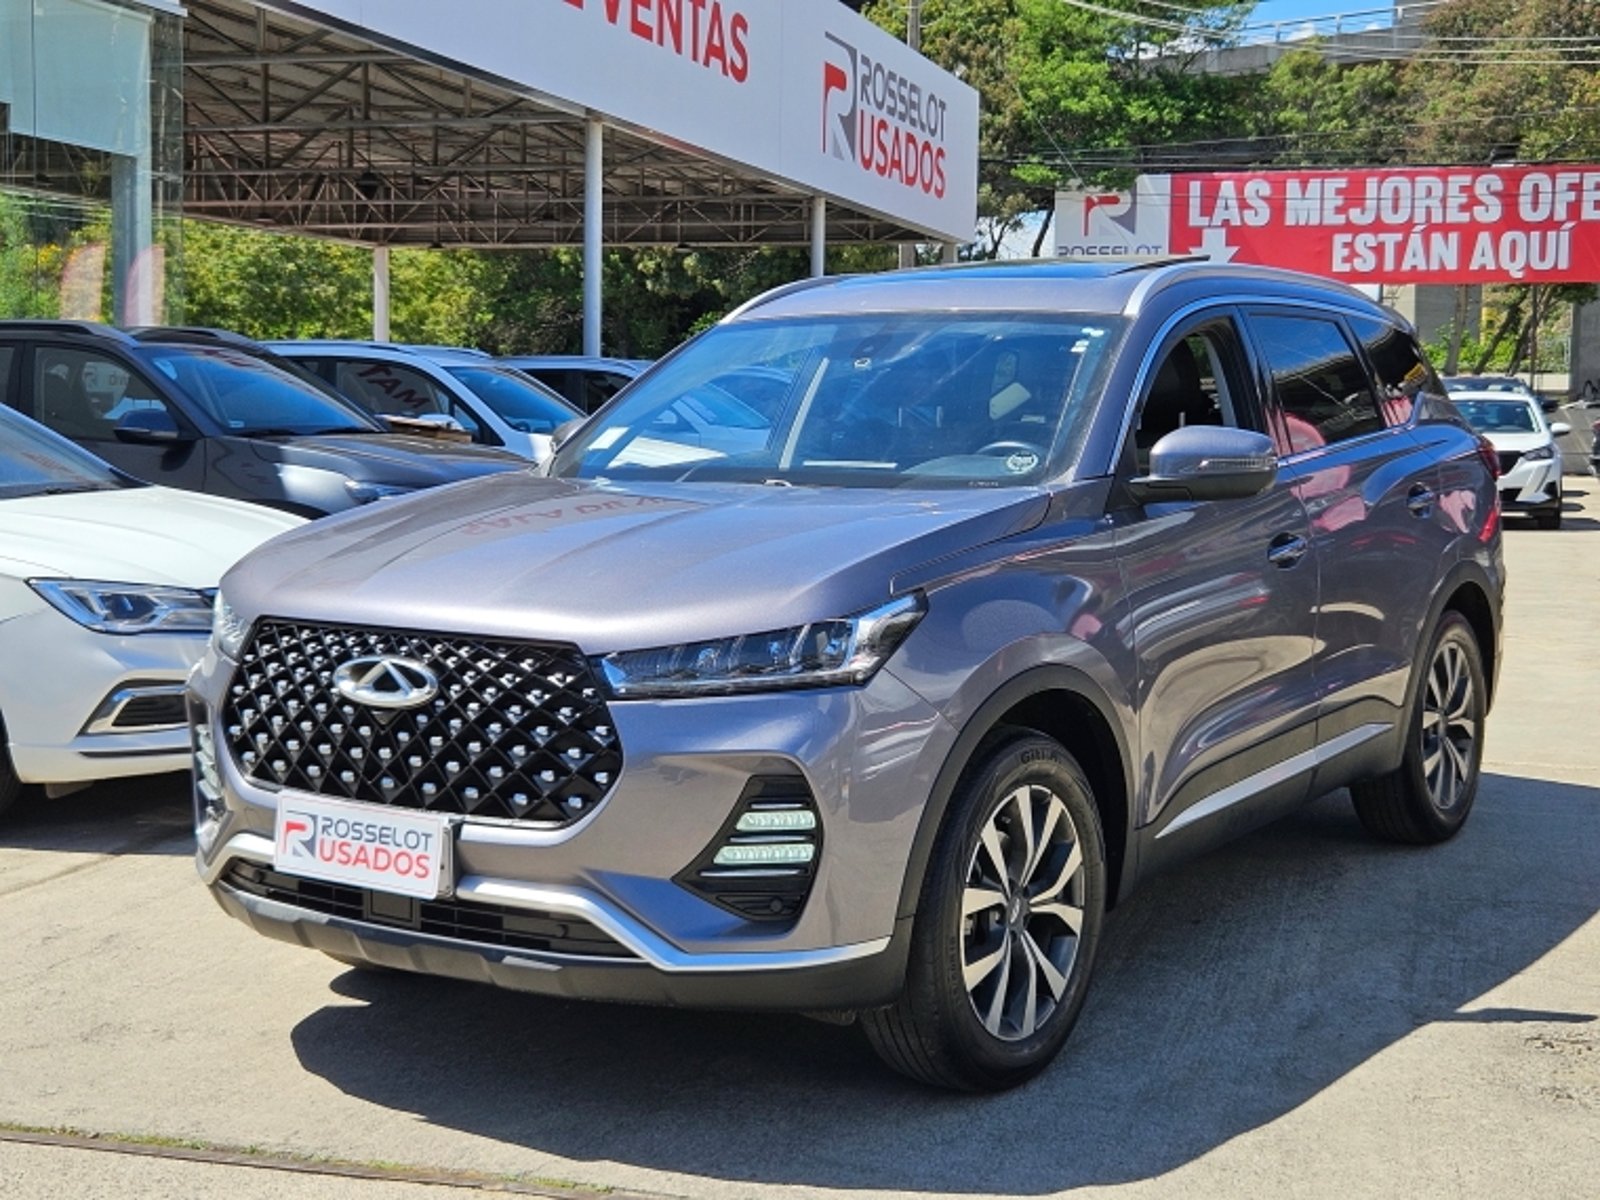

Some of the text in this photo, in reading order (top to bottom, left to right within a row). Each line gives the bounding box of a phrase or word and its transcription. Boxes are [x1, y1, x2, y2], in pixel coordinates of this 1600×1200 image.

[860, 54, 947, 142] ROSSELOT
[860, 109, 946, 199] USADOS
[1188, 172, 1600, 227] LAS MEJORES OFE
[1332, 221, 1577, 278] ESTÁN AQUÍ
[319, 838, 430, 879] USADOS
[321, 816, 433, 852] ROSSELOT
